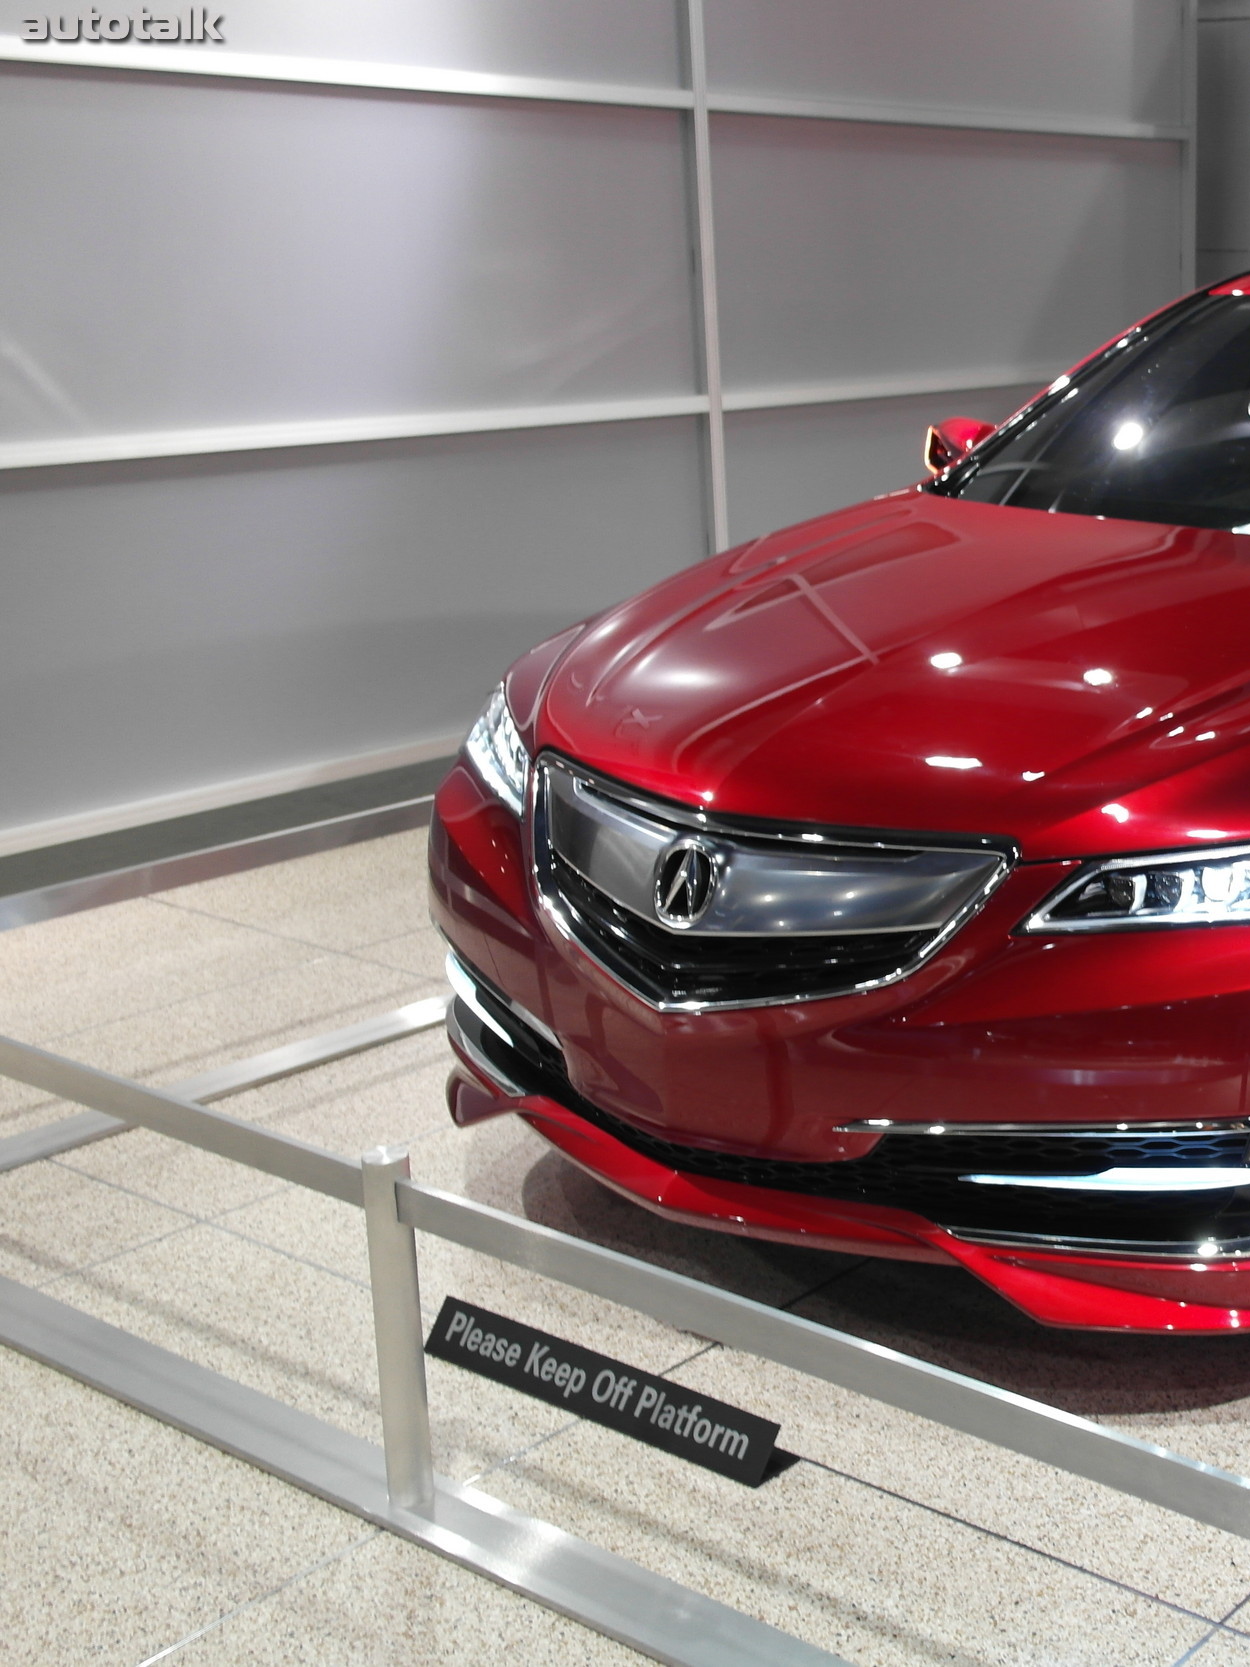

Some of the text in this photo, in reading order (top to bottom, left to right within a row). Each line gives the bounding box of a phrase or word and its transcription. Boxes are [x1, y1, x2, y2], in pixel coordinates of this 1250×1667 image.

[444, 1310, 749, 1461] Please Keep Off Platform
